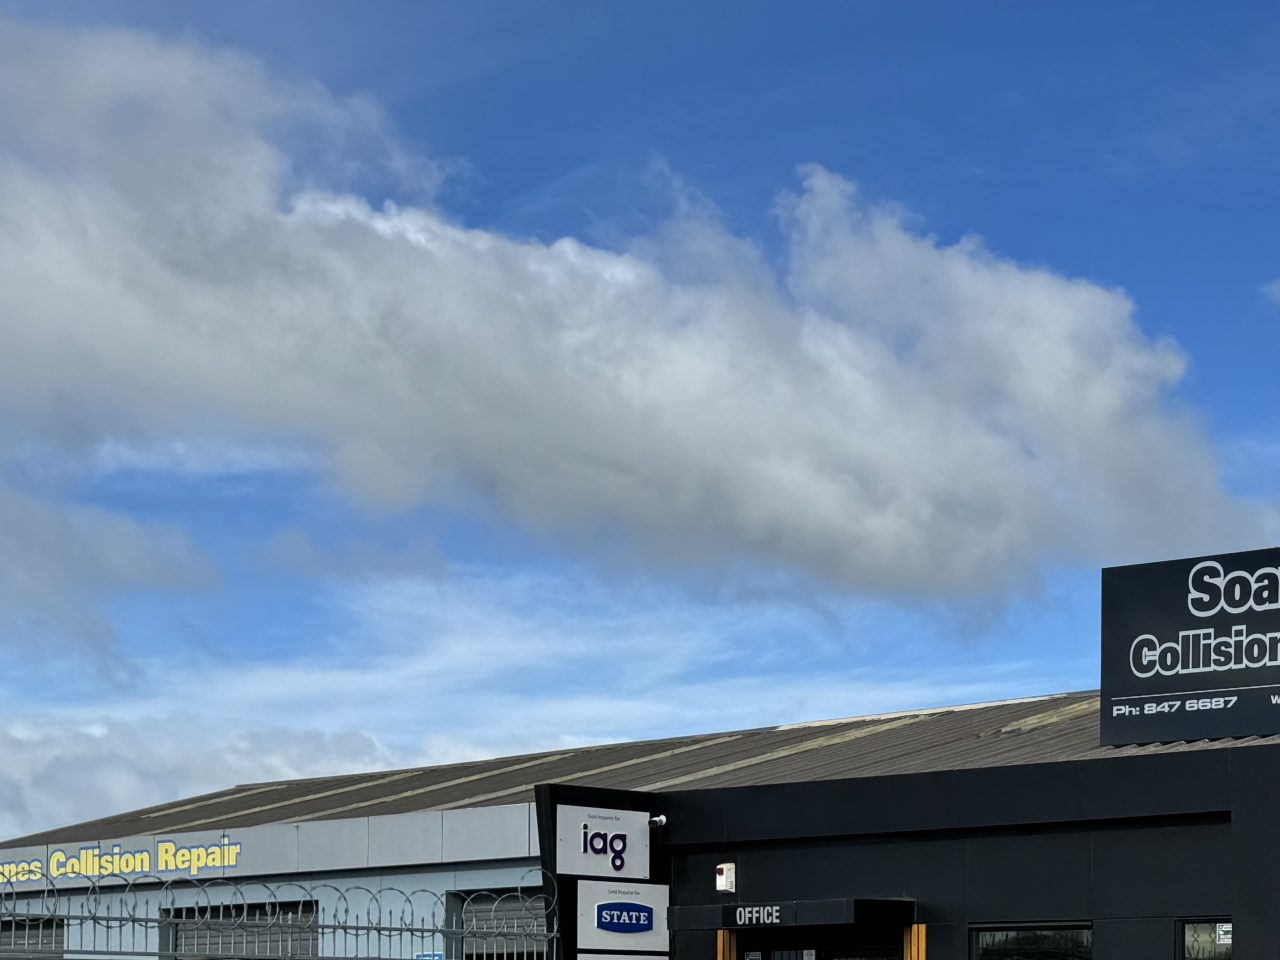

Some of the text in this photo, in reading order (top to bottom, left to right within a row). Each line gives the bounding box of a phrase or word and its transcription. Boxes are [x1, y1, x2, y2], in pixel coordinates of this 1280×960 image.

[1112, 696, 1238, 717] Ph: 847 6687
[50, 843, 150, 877] Collision
[157, 835, 241, 876] Repair
[582, 823, 627, 871] iag
[601, 910, 648, 924] STATE
[736, 906, 780, 925] OFFICE
